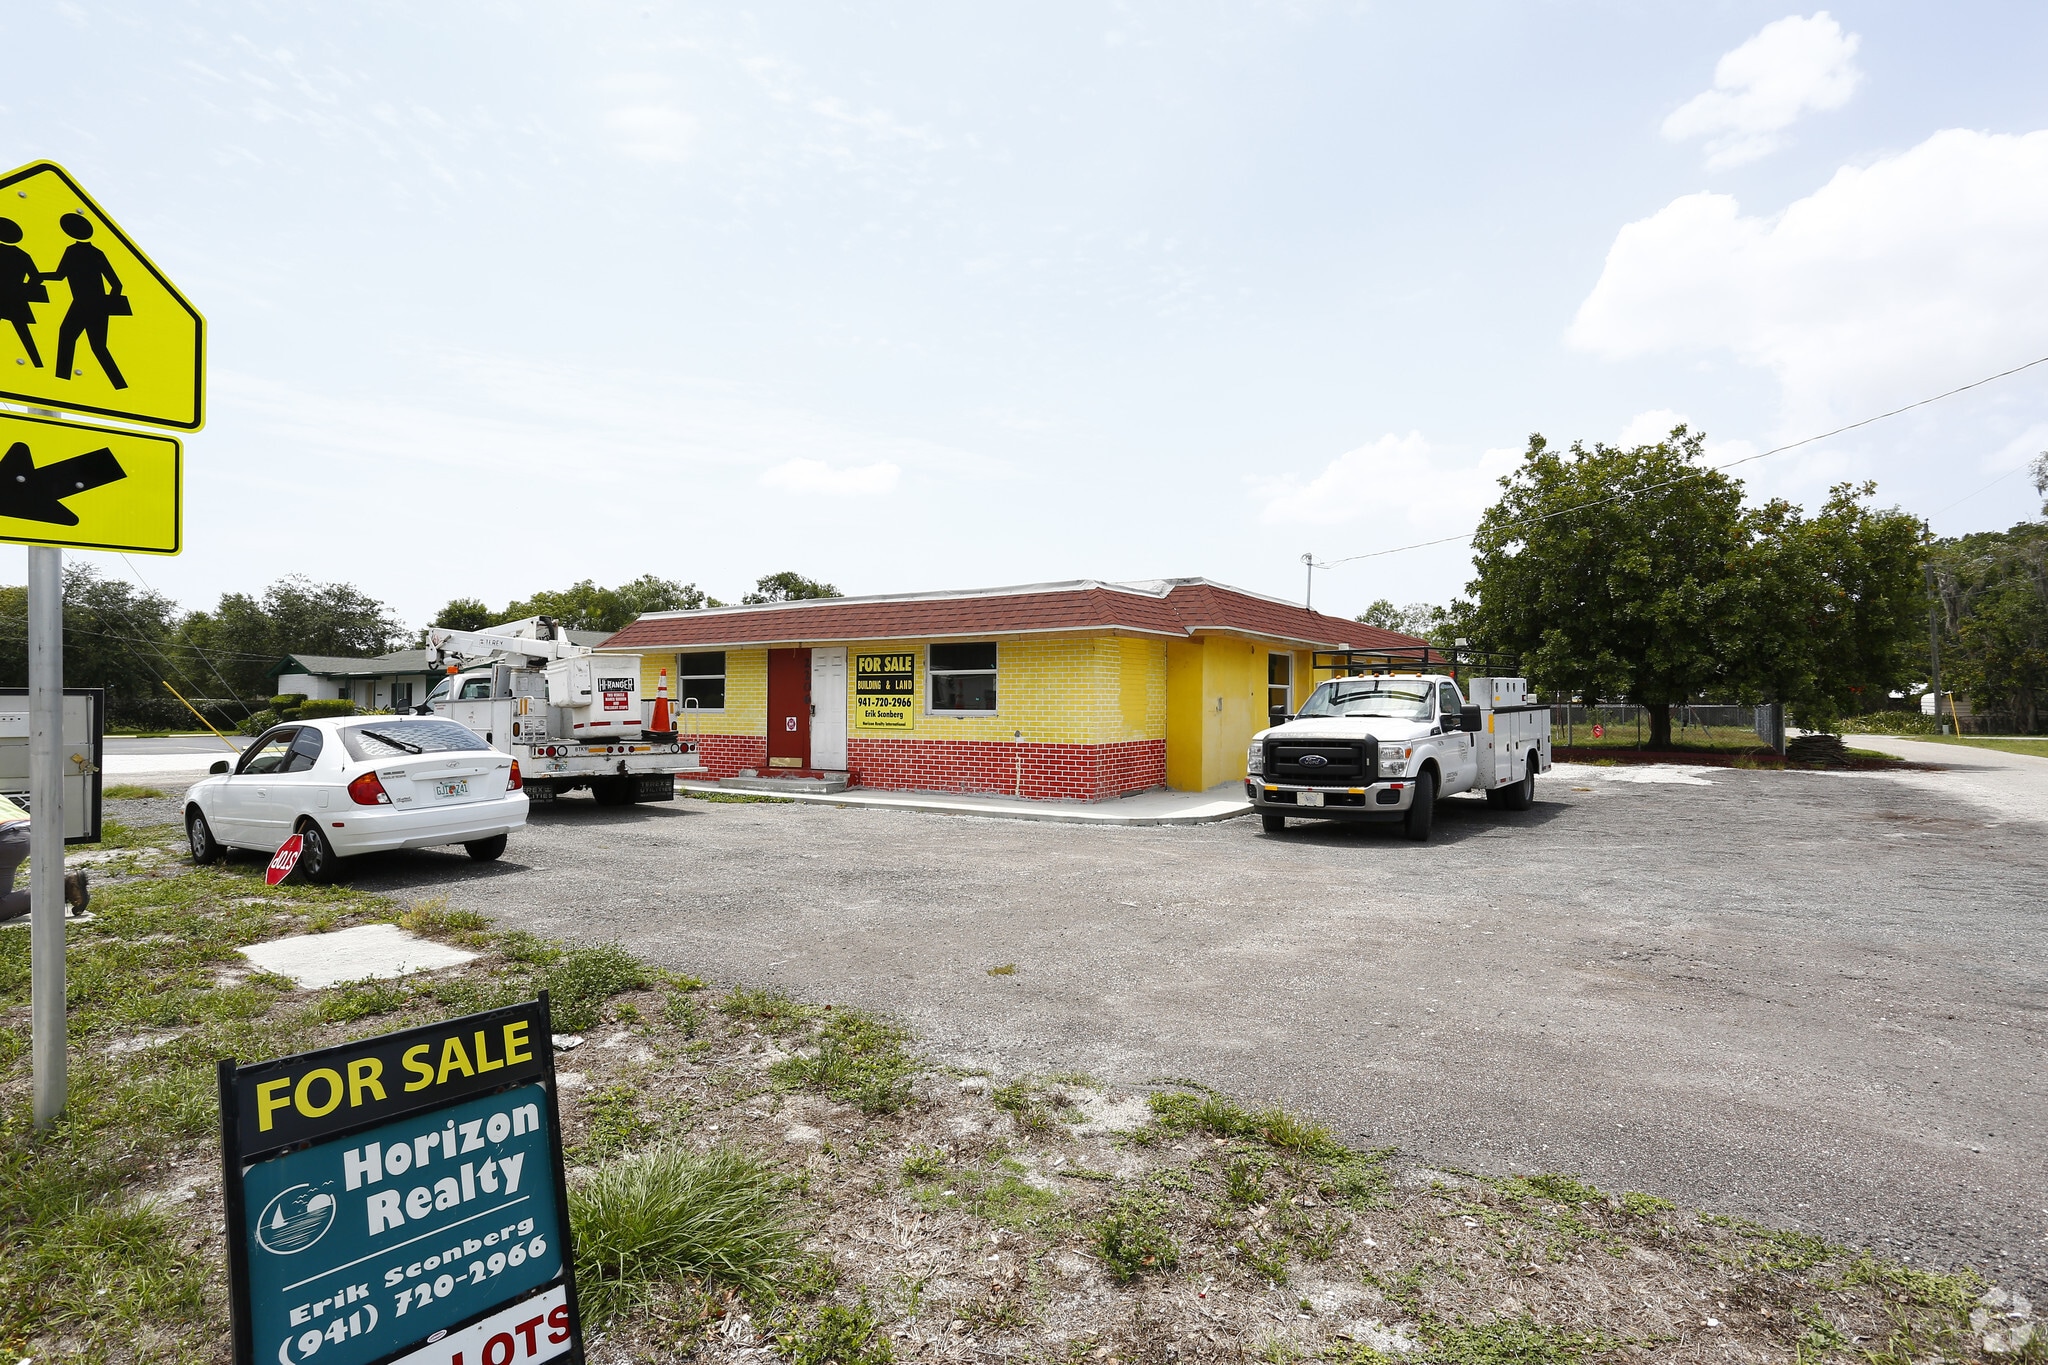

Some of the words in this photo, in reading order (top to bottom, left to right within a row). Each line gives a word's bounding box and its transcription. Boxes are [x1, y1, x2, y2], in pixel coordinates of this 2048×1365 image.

[858, 657, 881, 672] FOR
[884, 656, 912, 672] SALE
[858, 680, 881, 689] BUILDING
[885, 680, 891, 690] &
[895, 680, 912, 690] LAND
[857, 697, 912, 707] 941-720-2966
[865, 710, 876, 718] Erik
[877, 710, 904, 719] Sconberg
[1304, 757, 1320, 765] Ford
[271, 851, 298, 870] STOP
[256, 1057, 388, 1132] FOR
[403, 1020, 533, 1092] SALE
[343, 1102, 540, 1191] Horizon
[366, 1151, 525, 1236] Realty
[289, 1281, 370, 1328] Erik
[384, 1216, 535, 1289] Sconberg
[278, 1303, 379, 1365] (941)
[394, 1234, 547, 1318] 720-2966
